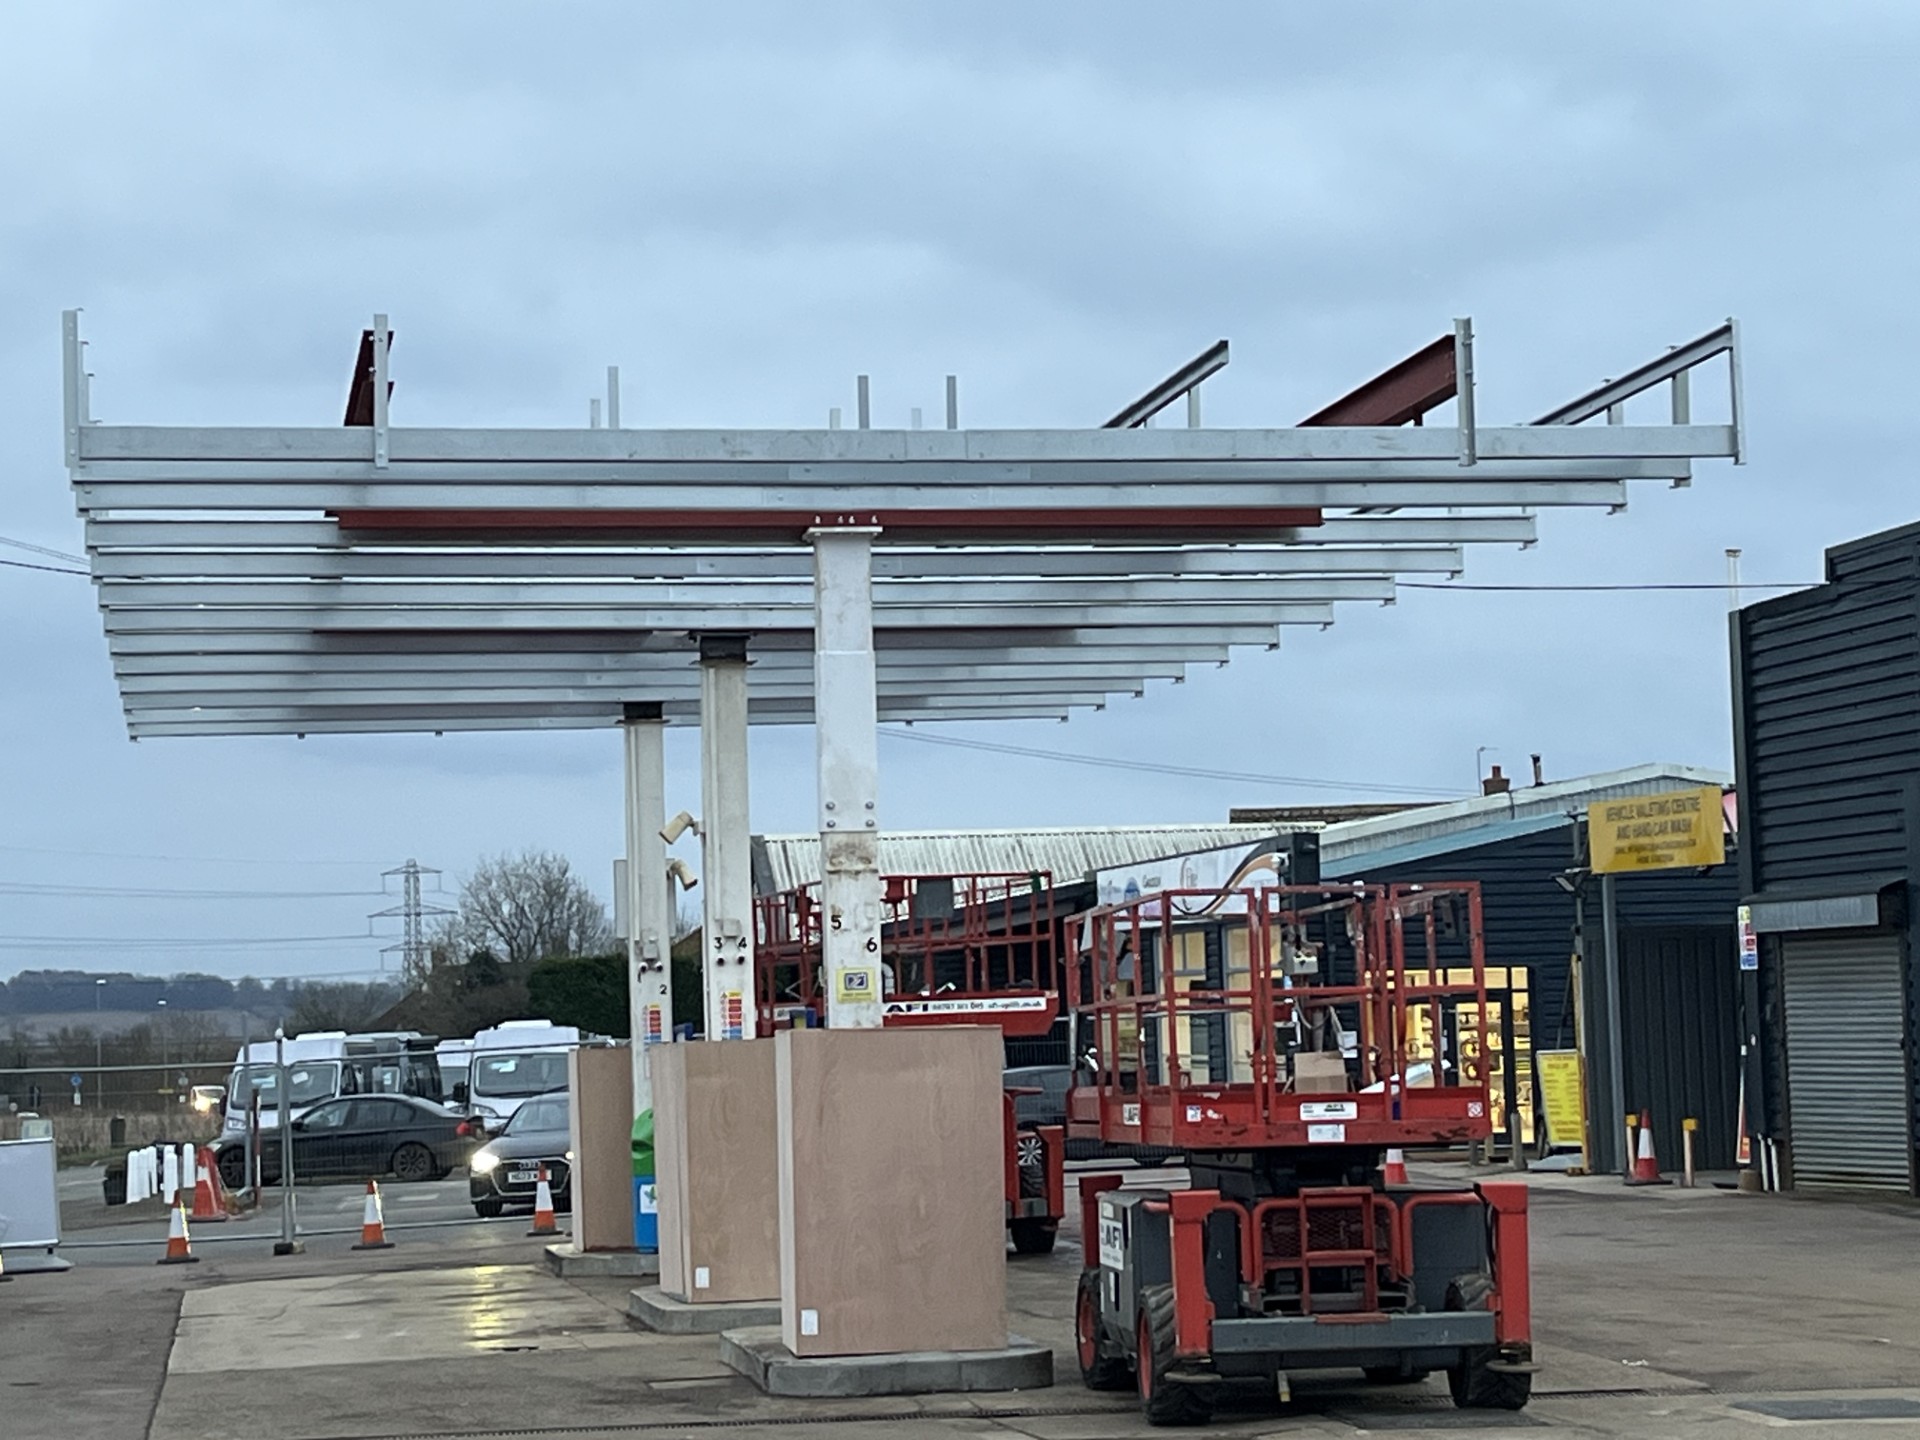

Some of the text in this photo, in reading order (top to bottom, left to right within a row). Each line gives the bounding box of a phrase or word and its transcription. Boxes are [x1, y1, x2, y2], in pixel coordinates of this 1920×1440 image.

[831, 914, 842, 930] 5
[714, 936, 723, 949] 3
[738, 936, 747, 949] 4
[866, 937, 878, 953] 6
[660, 984, 668, 995] 2
